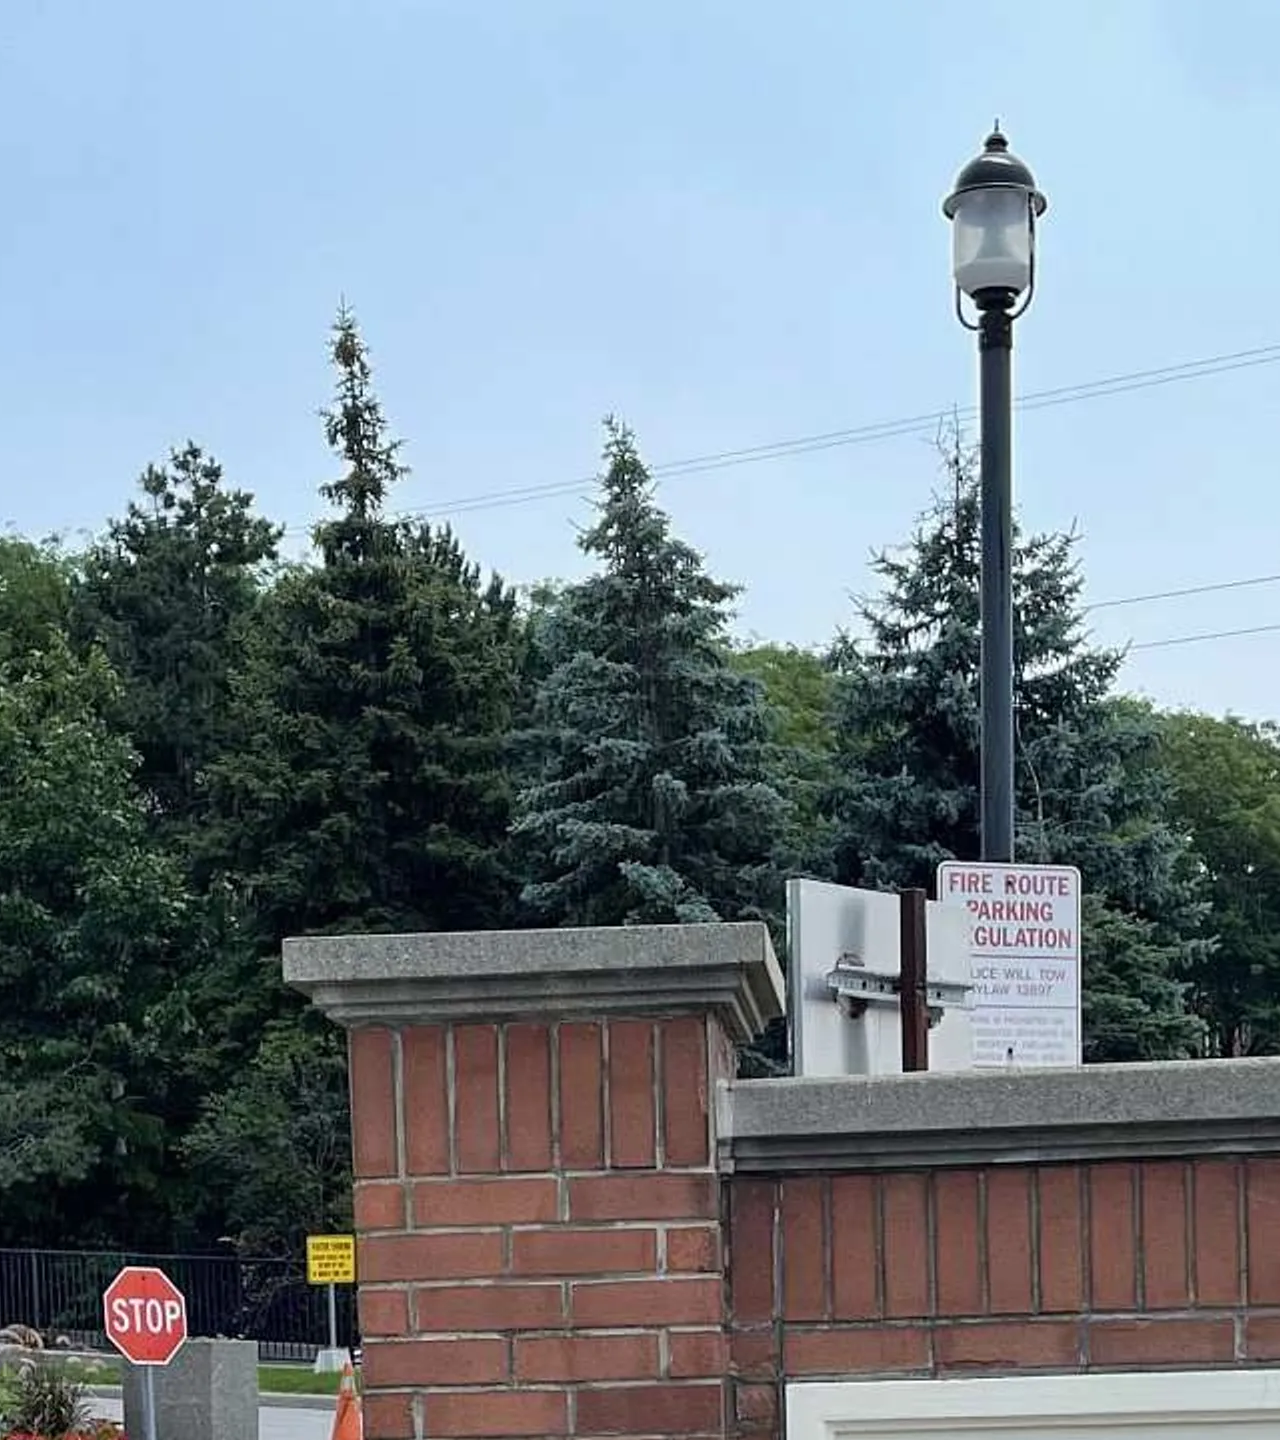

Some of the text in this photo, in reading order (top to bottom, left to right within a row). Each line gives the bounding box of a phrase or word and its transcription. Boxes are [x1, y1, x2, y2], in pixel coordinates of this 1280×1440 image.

[949, 871, 1070, 896] FIRE ROUTE
[970, 925, 1072, 949] GULATION
[112, 1297, 181, 1335] STOP
